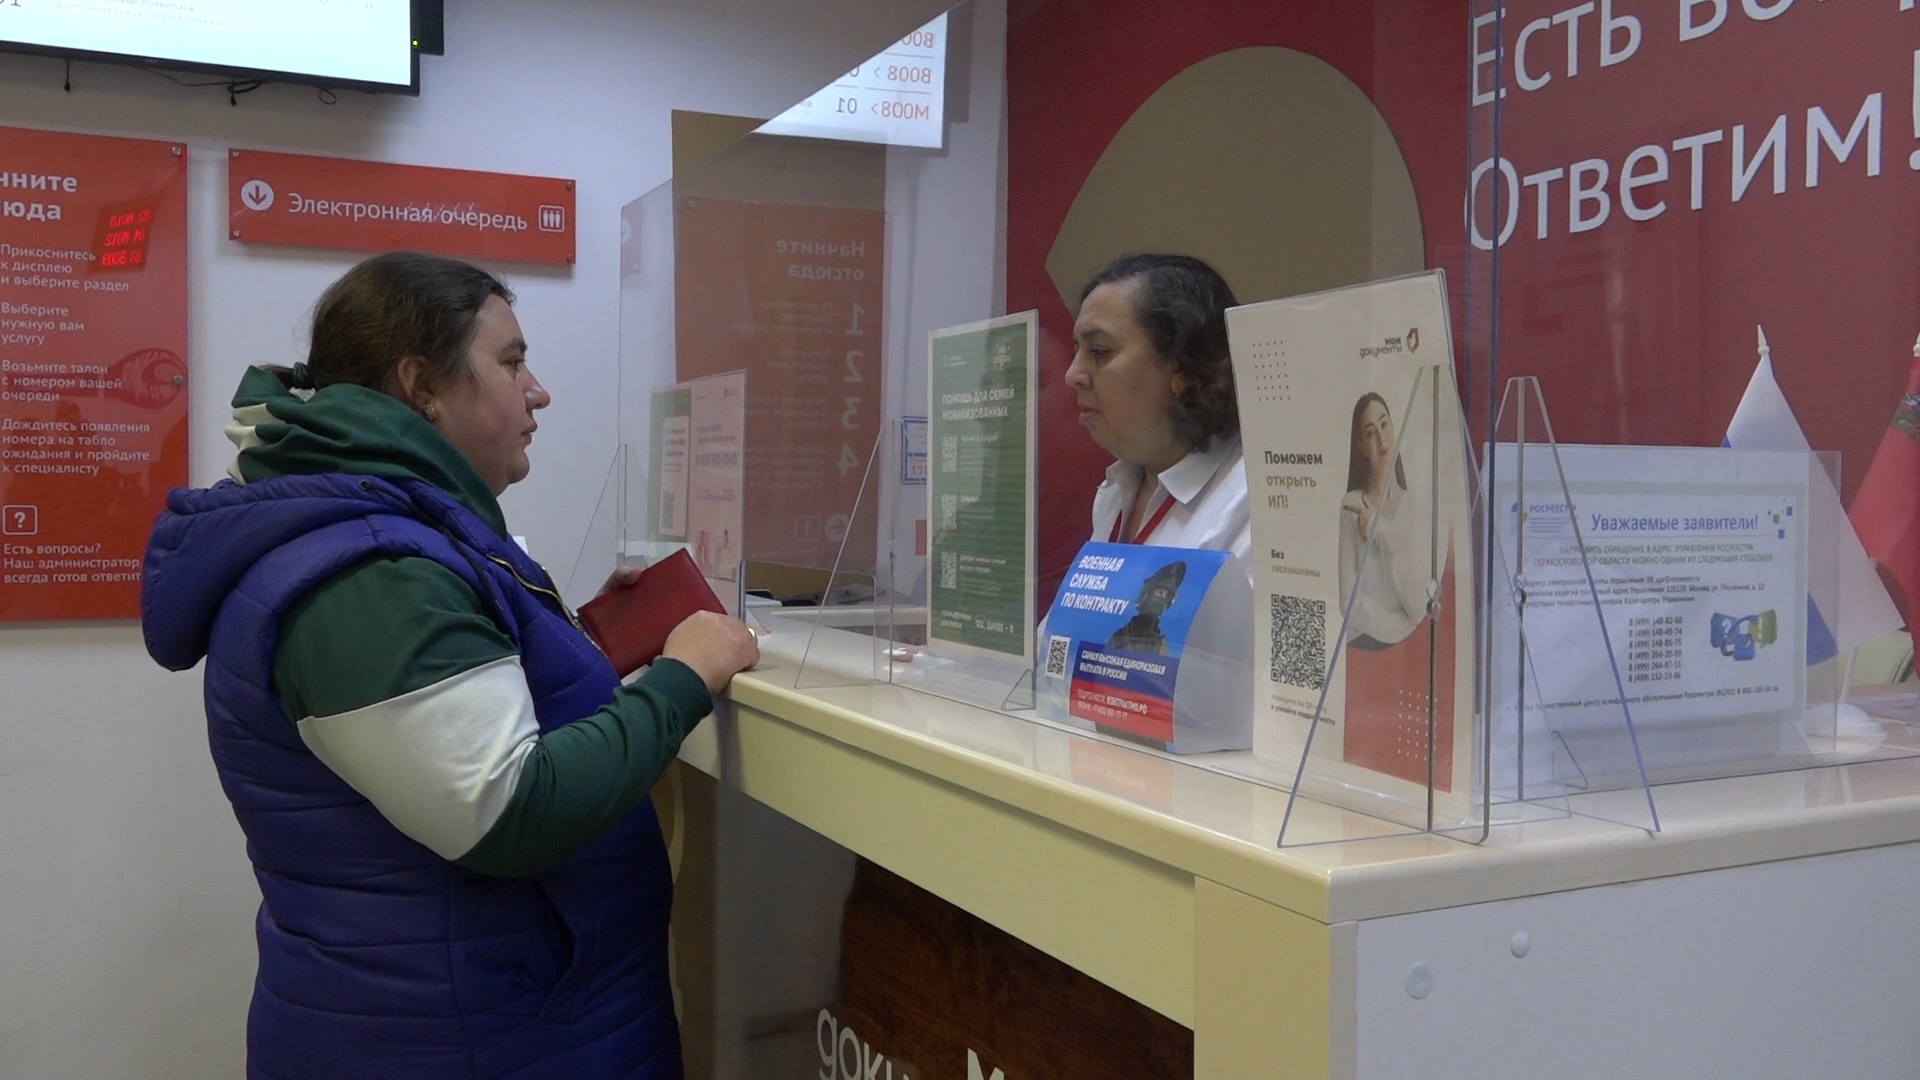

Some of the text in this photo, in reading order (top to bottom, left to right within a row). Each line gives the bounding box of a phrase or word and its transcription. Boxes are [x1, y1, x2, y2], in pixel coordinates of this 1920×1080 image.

[1473, 0, 1642, 107] Есть
[288, 192, 527, 232] Электронная очередь
[1, 244, 96, 261] Прикоснитесь
[1, 262, 72, 274] к дисплею
[1, 276, 129, 294] и выберите раздел
[1, 302, 69, 317] Выберите
[1, 319, 85, 332] нужную вам
[1, 334, 45, 346] услугу
[2, 360, 108, 374] Возьмите талон
[2, 377, 122, 390] с номером вашей
[2, 391, 60, 402] очереди
[973, 390, 988, 404] ДЛЯ
[989, 384, 1015, 400] СЕМЕЙ
[2, 418, 150, 433] Дождитесь появления
[2, 434, 116, 447] номера на табло
[2, 448, 150, 461] ожидания и пройдите
[1264, 450, 1323, 465] Поможем
[3, 463, 100, 476] к специалисту
[1266, 474, 1317, 489] открыть
[1268, 494, 1288, 509] ИП!
[1591, 513, 1679, 531] Уважаемые
[1683, 514, 1758, 531] заявители!
[3, 543, 101, 555] Есть вопросы?
[1271, 549, 1285, 560] Без
[4, 558, 140, 570] Наш администратор
[1079, 555, 1125, 573] ВОЕННАЯ
[4, 572, 142, 584] всегда готов ответит
[1069, 573, 1109, 591] СЛУЖБА
[1060, 592, 1129, 616] ПО КОНТРАКТУ
